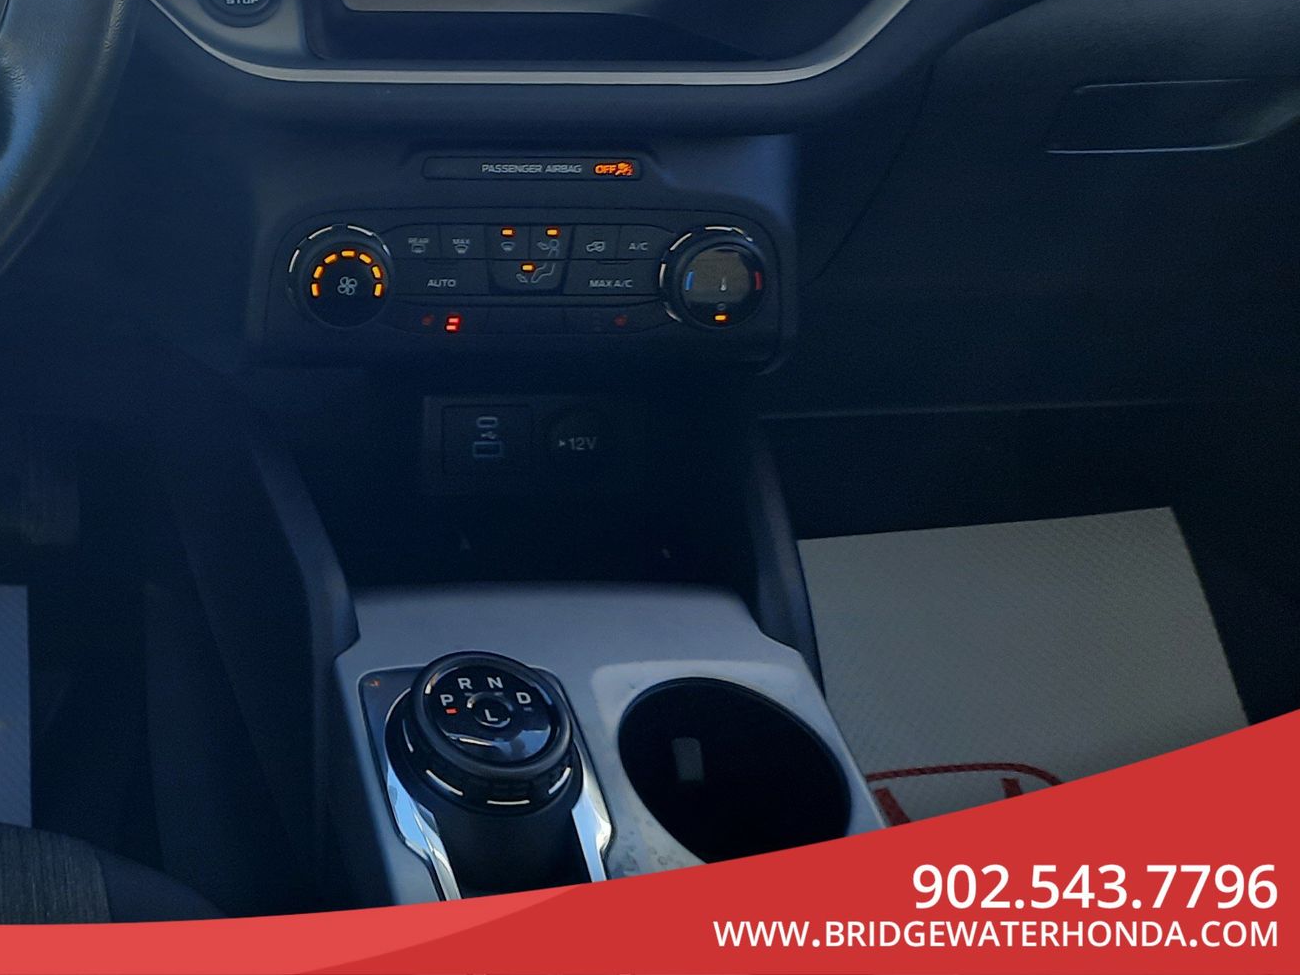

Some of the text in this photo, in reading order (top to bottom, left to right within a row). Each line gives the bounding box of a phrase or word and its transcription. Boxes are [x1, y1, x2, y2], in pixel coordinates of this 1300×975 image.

[481, 163, 582, 174] PASSENGER AIRBAG
[594, 164, 617, 174] OFF
[628, 242, 649, 252] A/C
[427, 279, 457, 289] AUTO
[589, 279, 634, 289] MAX A/C
[569, 436, 597, 451] 12V
[457, 677, 473, 691] R
[487, 676, 504, 690] N
[440, 693, 455, 707] P
[516, 692, 532, 705] D
[484, 709, 499, 722] L
